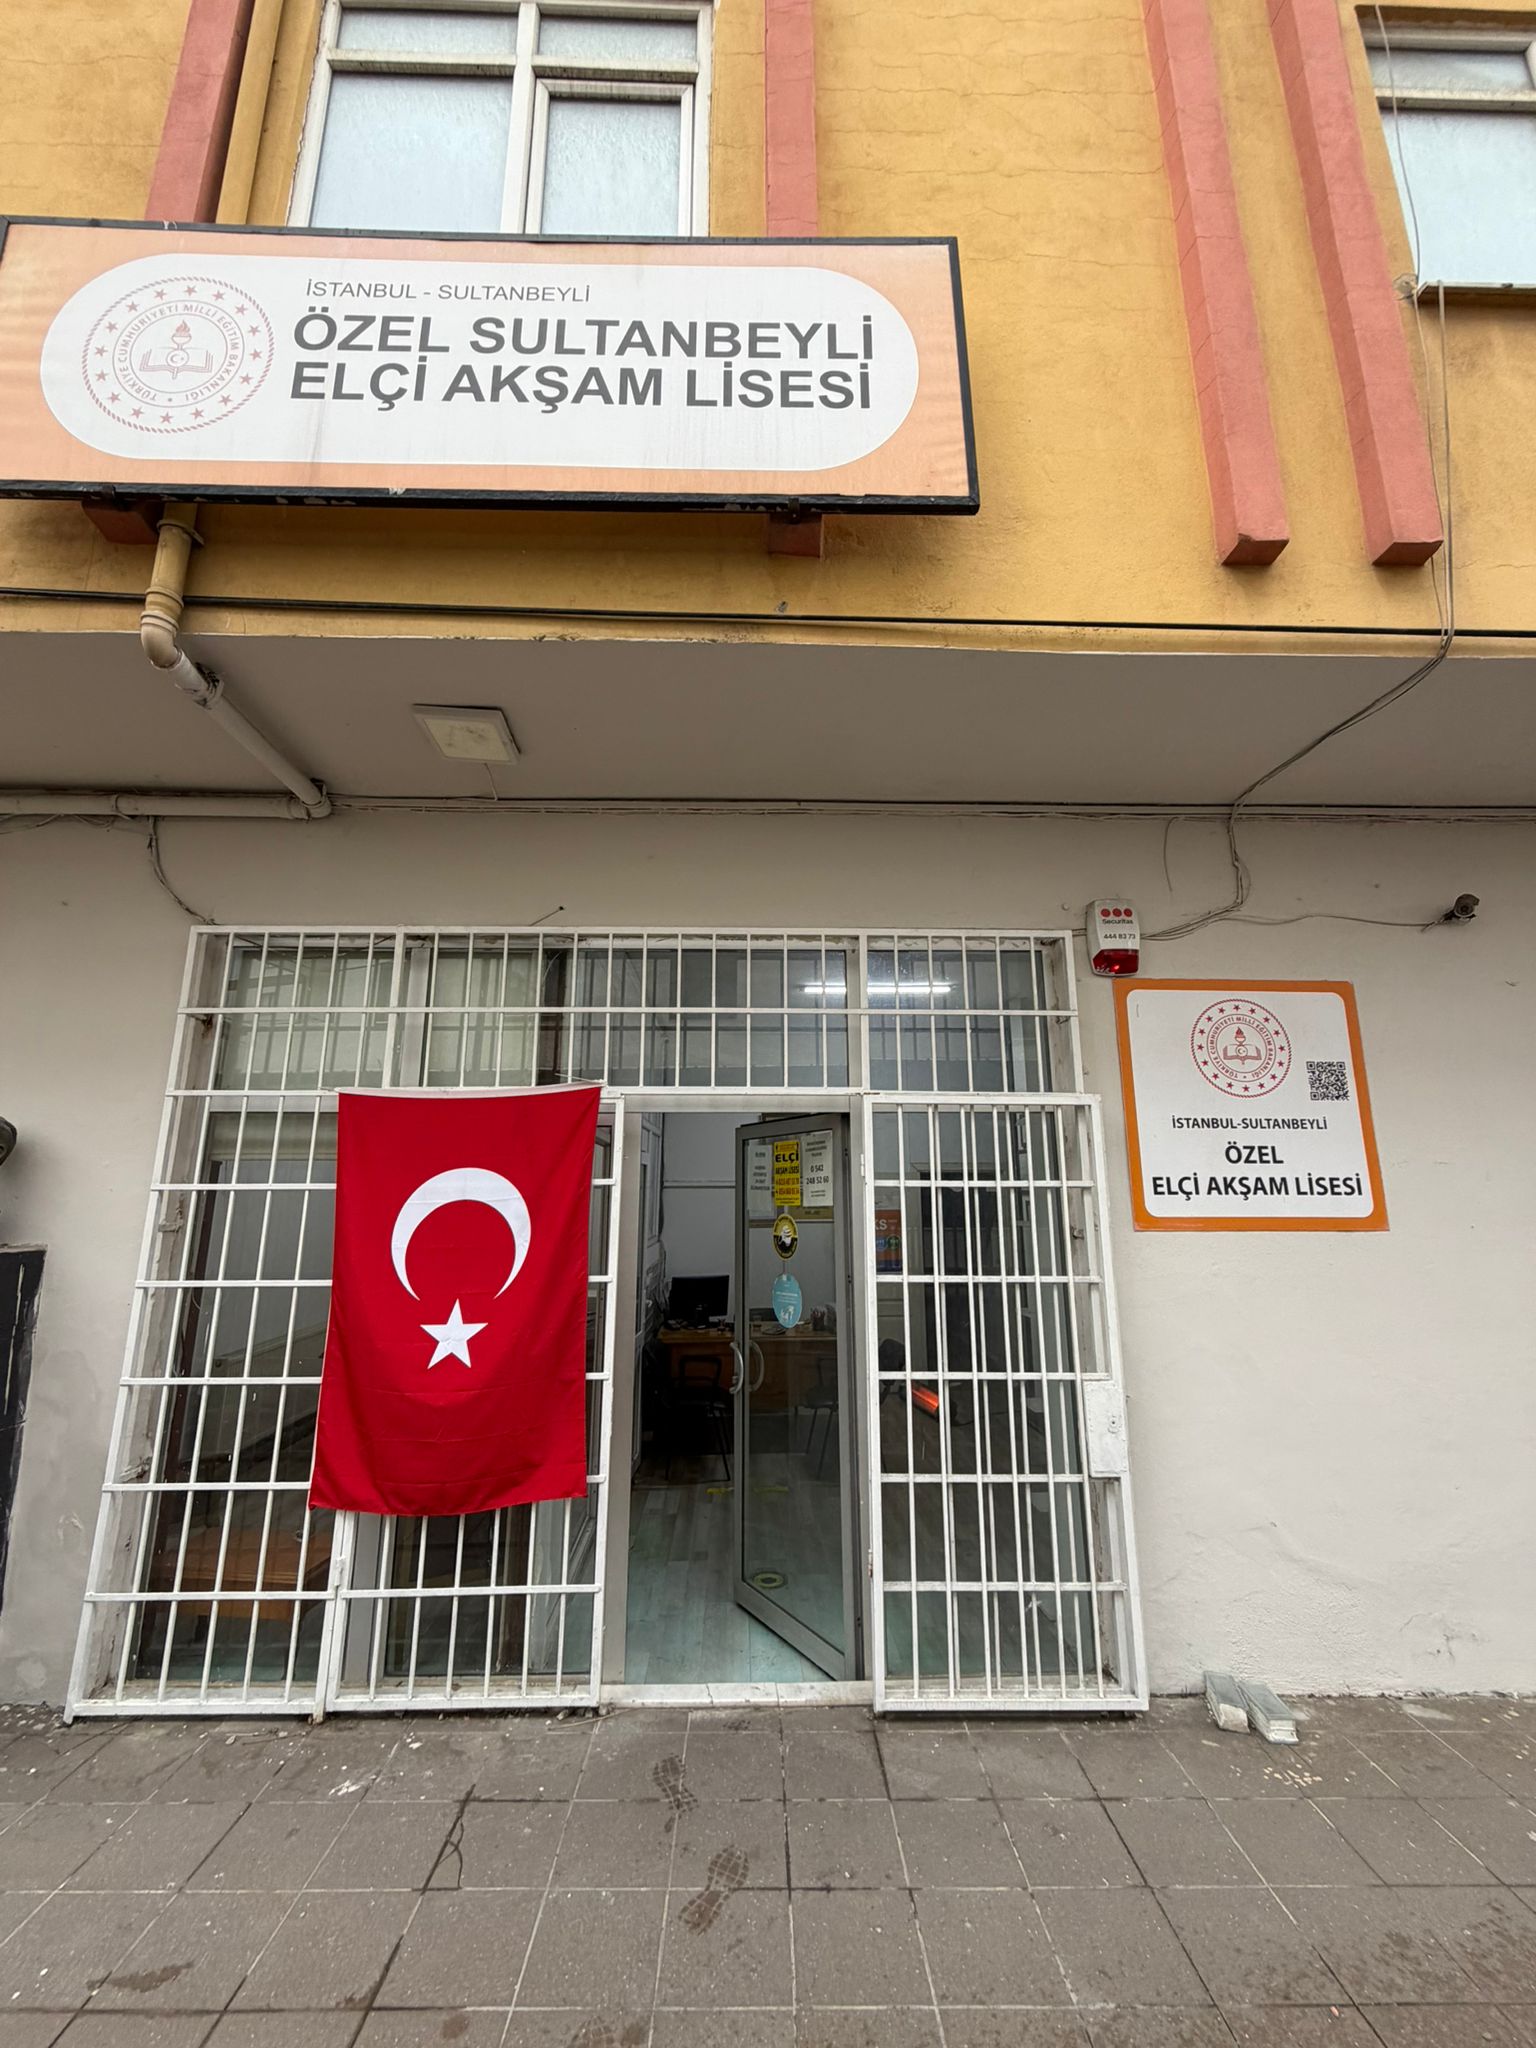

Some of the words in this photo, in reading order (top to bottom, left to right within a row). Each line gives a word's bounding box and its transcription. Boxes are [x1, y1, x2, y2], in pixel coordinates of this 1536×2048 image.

[307, 279, 416, 299] İSTANBUL
[439, 284, 590, 302] SULTANBEYLİ
[117, 304, 179, 362] CUMHURİYETİ
[183, 303, 217, 319] MİLLİ
[217, 315, 241, 351] EĞİTİM
[294, 306, 450, 353] ÖZEL
[469, 315, 873, 360] SULTANBEYLİ
[290, 356, 427, 411] ELÇİ
[442, 364, 662, 414] AKŞAM
[686, 361, 870, 409] LİSESİ
[1172, 1114, 1328, 1130] İSTANBUL-SULTANBEYLİ
[775, 1150, 799, 1163] ELÇİ
[1225, 1141, 1284, 1164] ÖZEL
[1152, 1173, 1200, 1201] ELÇİ
[1206, 1177, 1290, 1201] AKŞAM
[1294, 1173, 1363, 1196] LİSESİ
